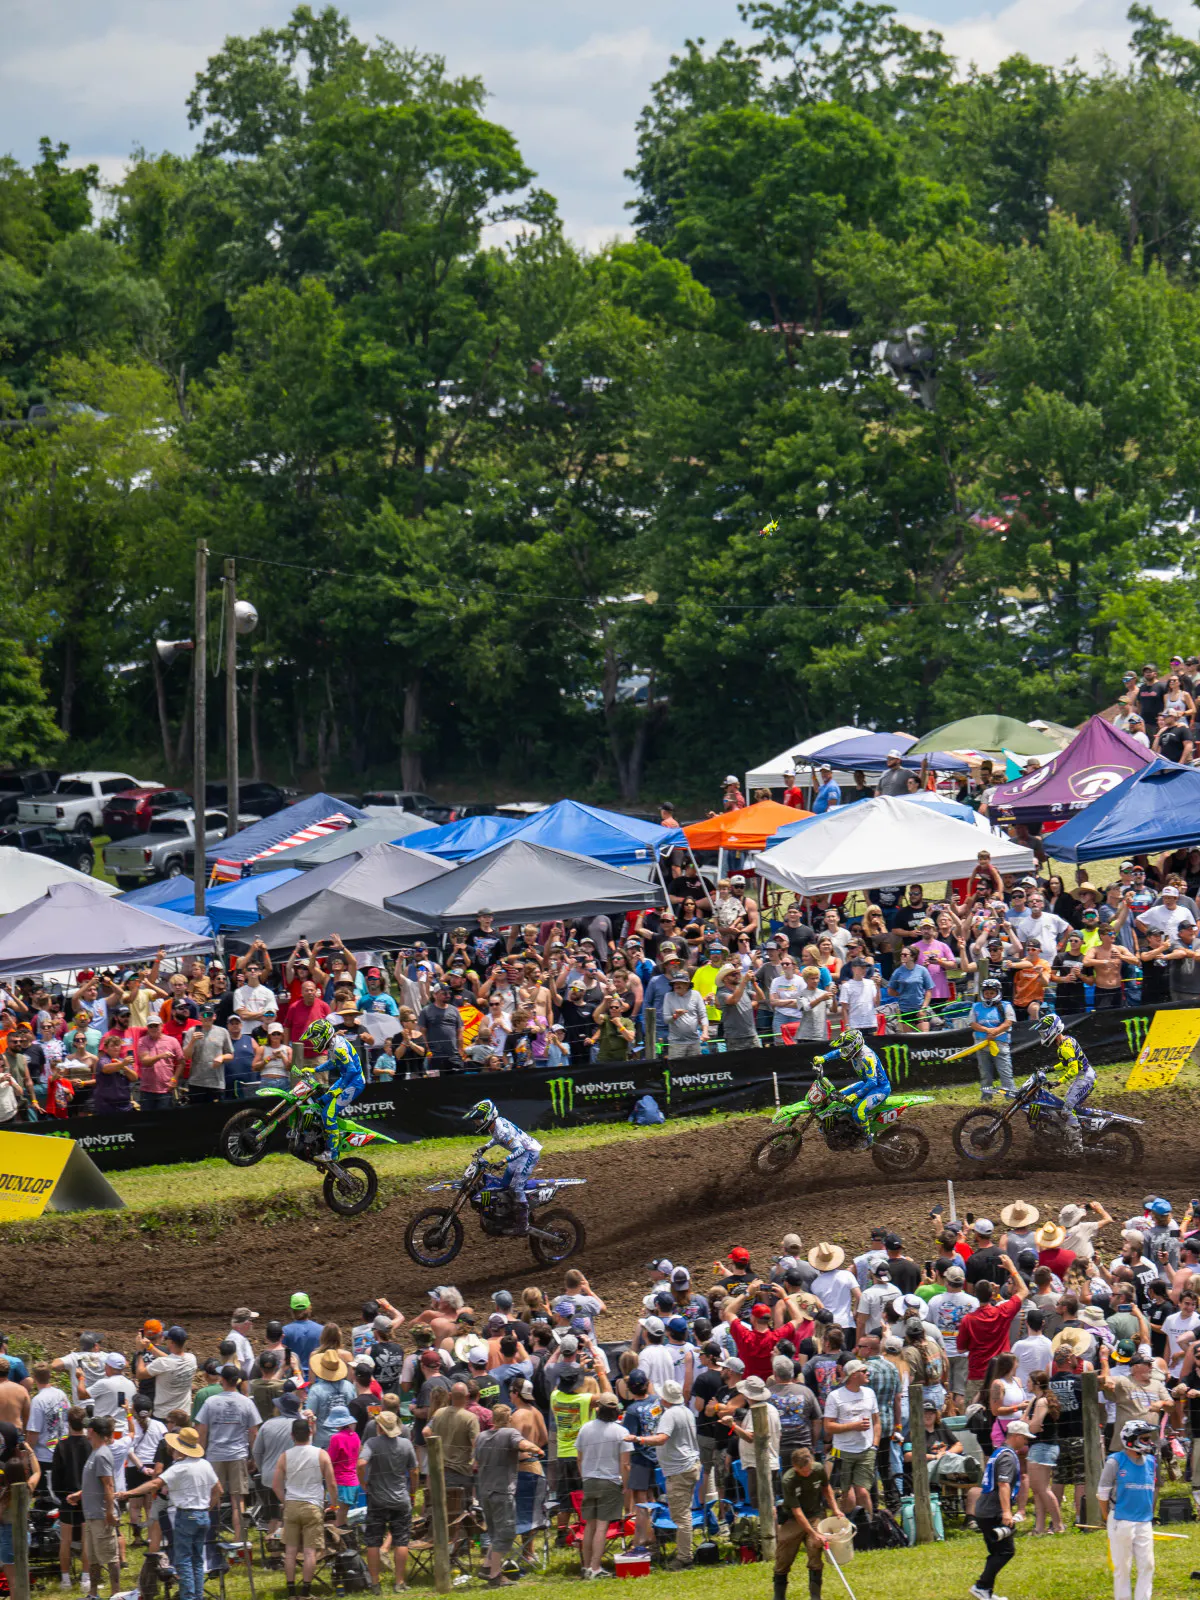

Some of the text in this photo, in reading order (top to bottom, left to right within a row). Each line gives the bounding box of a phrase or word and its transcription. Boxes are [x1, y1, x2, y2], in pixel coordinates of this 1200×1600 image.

[672, 1071, 733, 1086] MONSTER
[575, 1080, 636, 1095] MONSTER
[682, 1083, 726, 1093] ENERGY
[1074, 1083, 1091, 1100] THOR
[585, 1093, 628, 1101] ENERGY
[881, 1110, 898, 1124] 10
[1090, 1117, 1107, 1131] 37
[520, 1152, 535, 1177] THOR
[0, 1173, 53, 1194] DUNLOP
